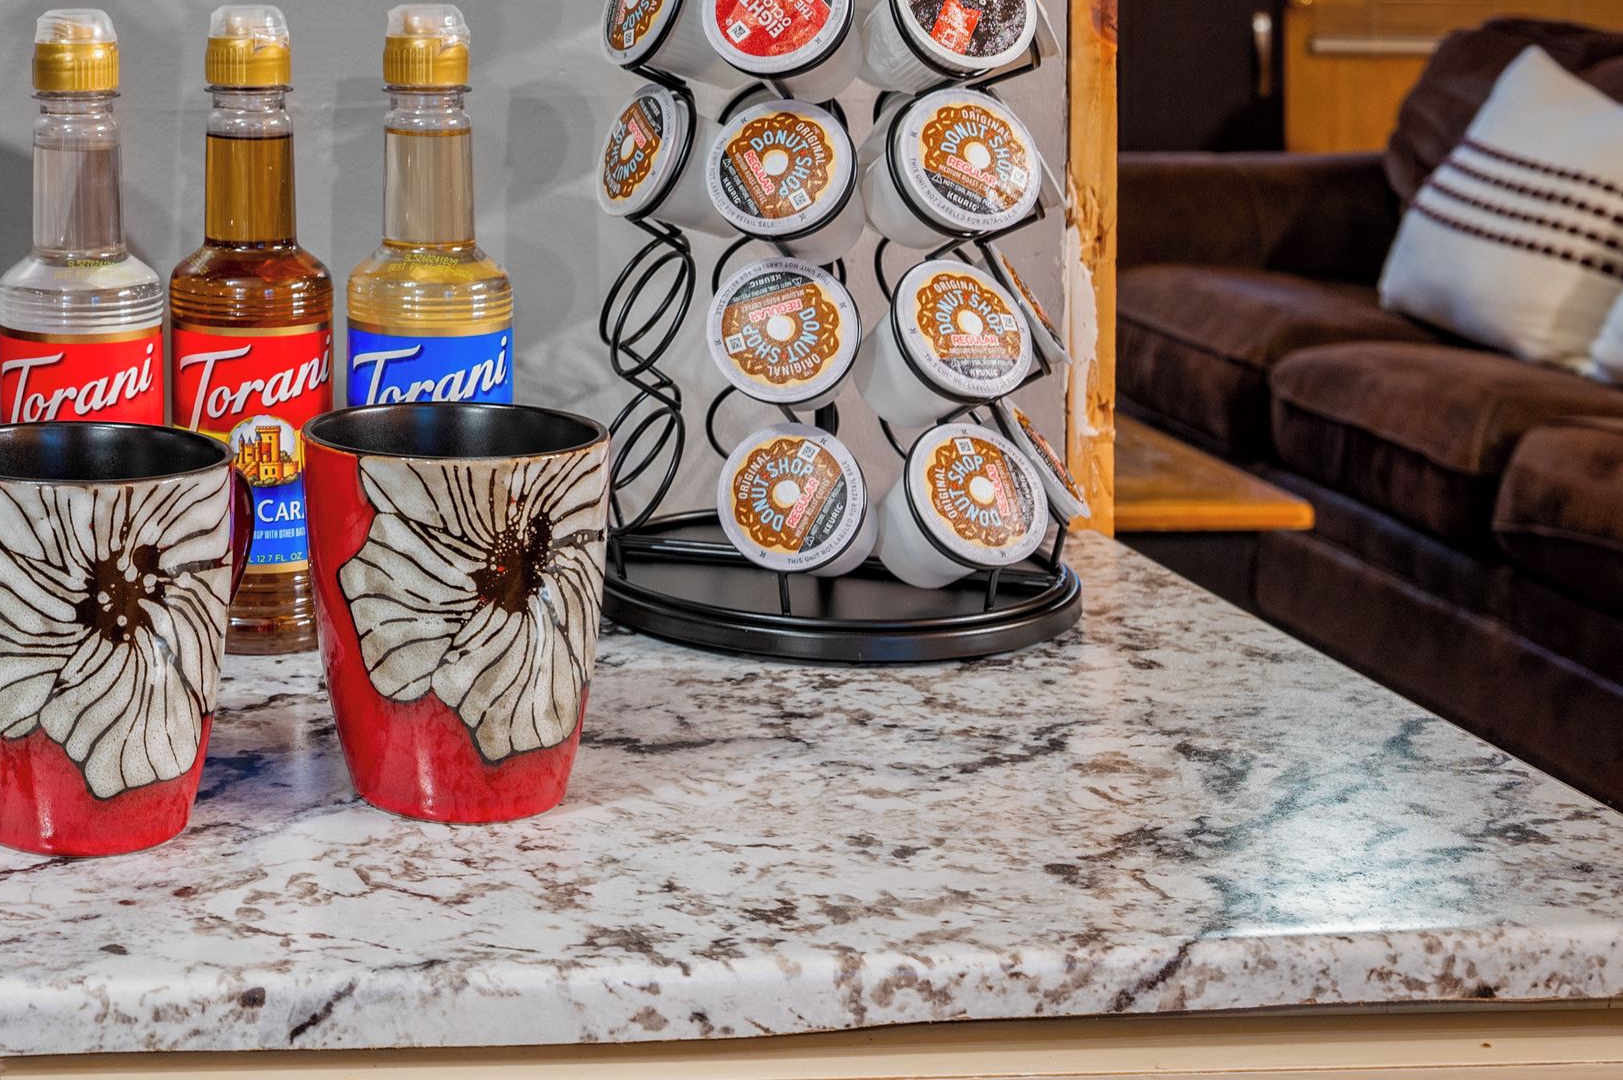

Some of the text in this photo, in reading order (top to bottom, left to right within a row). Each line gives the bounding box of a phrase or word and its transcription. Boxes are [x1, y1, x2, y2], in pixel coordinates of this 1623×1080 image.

[793, 0, 813, 19] THE
[796, 123, 826, 165] ORIGINAL
[961, 109, 1010, 141] ORIGINAL
[613, 150, 644, 181] DONUT
[750, 129, 813, 197] DONUT SHOP
[940, 121, 1011, 181] DONUT SHOP
[946, 155, 998, 188] REGULAR
[722, 176, 741, 204] KEURIG
[743, 149, 775, 196] REGULAR
[910, 158, 919, 173] THIS
[926, 189, 938, 202] NOT
[945, 191, 978, 210] KEURIG
[749, 274, 782, 289] KEURIG
[933, 280, 981, 294] ORIGINAL
[749, 298, 803, 323] REGULAR
[936, 289, 1005, 335] DONUT SHOP
[742, 307, 820, 364] DONUT SHOP
[951, 334, 1000, 346] REGULAR
[2, 342, 154, 424] Torani
[180, 334, 331, 432] Torani
[353, 335, 507, 406] Torani
[767, 353, 821, 377] ORIGINAL
[738, 452, 771, 500] ORIGINAL
[751, 456, 814, 532] DONUT SHOP
[935, 467, 957, 519] ORIGINAL
[948, 455, 1002, 527] DONUT SHOP
[985, 463, 1011, 517] REGULAR
[257, 499, 305, 523] CAR
[785, 477, 820, 529] REGULAR
[822, 502, 844, 534] KEURIG
[257, 554, 273, 563] 12.7
[290, 551, 303, 560] OZ
[821, 544, 834, 555] NOT
[834, 518, 853, 546] LABELED
